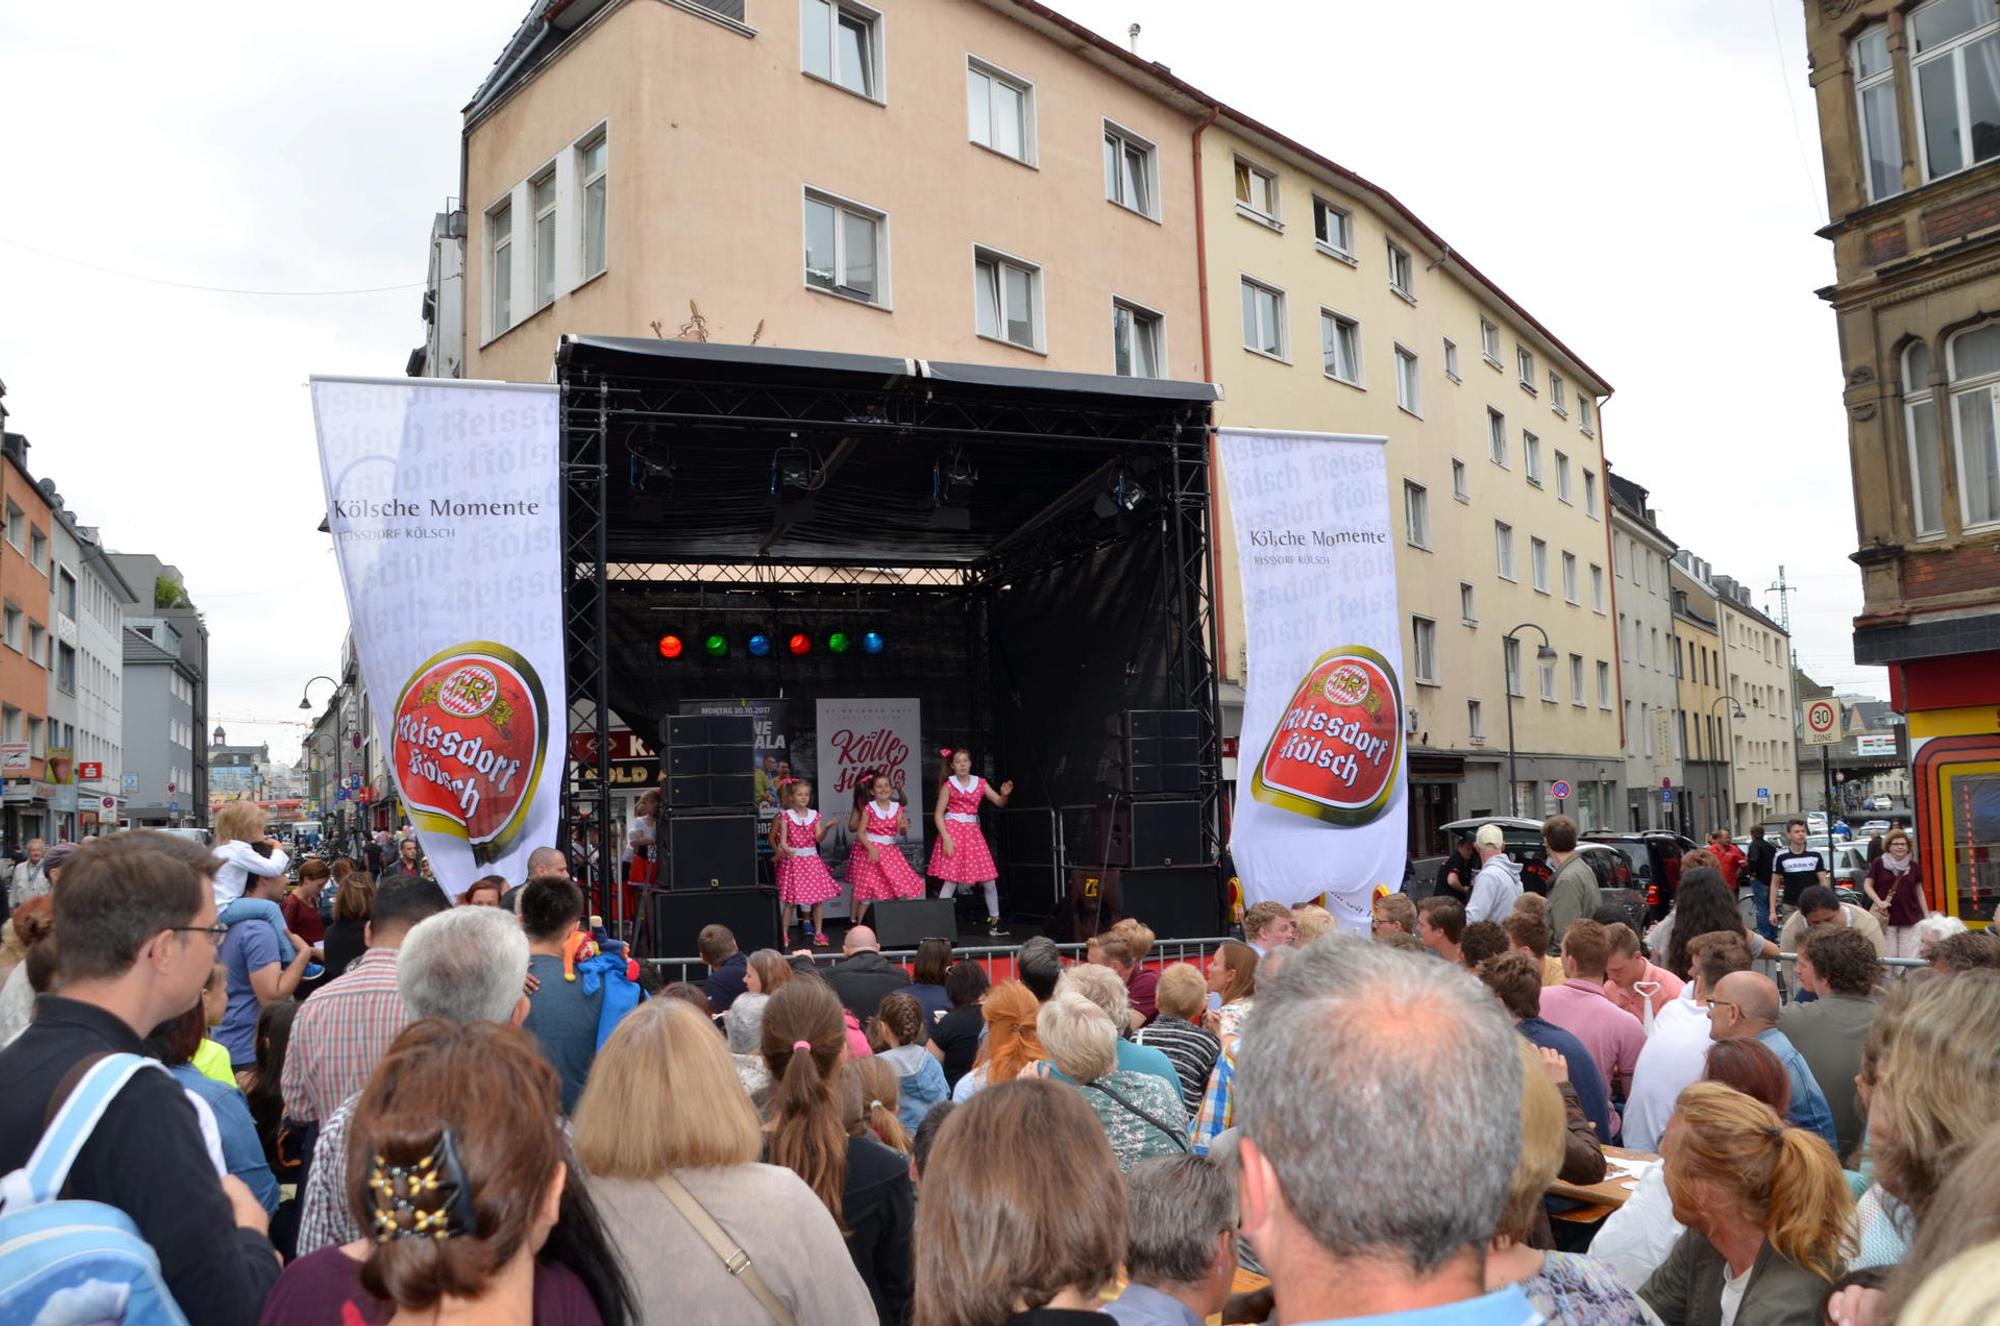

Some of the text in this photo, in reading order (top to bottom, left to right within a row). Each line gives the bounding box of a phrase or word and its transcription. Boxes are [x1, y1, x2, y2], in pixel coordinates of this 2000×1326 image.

[333, 497, 541, 518] Kölsche Momente
[405, 525, 456, 540] KÖLSCH
[1312, 529, 1387, 547] Momente
[1814, 710, 1829, 725] 30
[753, 734, 786, 749] ALA
[831, 728, 909, 766] Kölle
[1812, 733, 1833, 743] ZONE
[398, 712, 521, 792] Reissdorf
[1280, 732, 1360, 788] Kölsch
[408, 747, 481, 818] Kölsch
